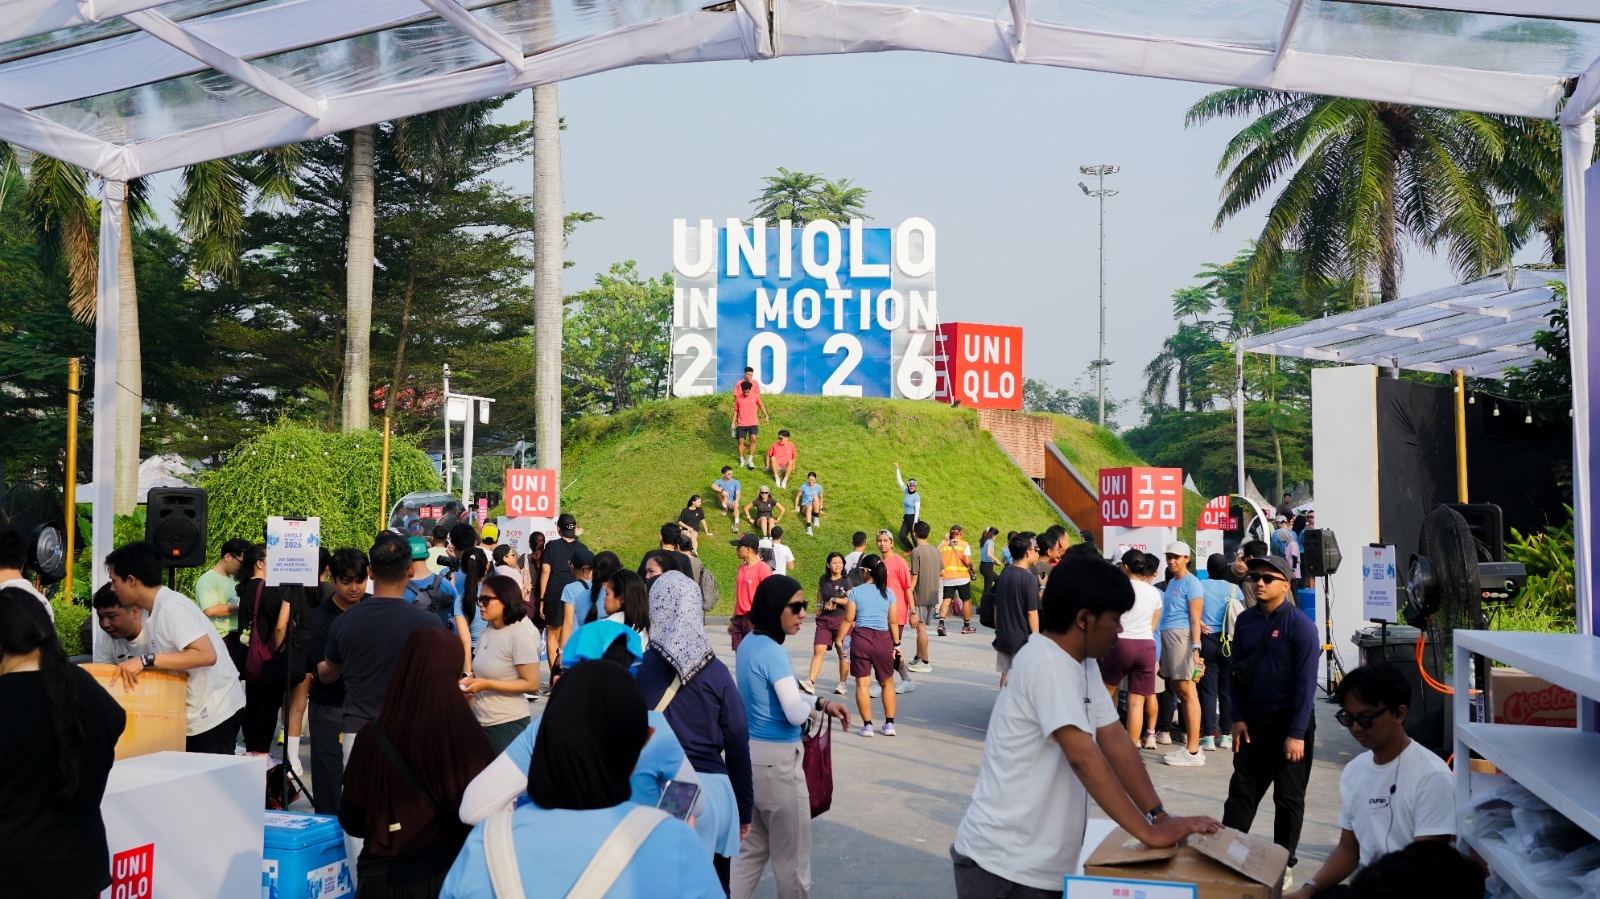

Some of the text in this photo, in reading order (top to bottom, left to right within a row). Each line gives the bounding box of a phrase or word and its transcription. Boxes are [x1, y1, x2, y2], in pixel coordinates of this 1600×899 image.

[673, 217, 936, 289] UNIQLO
[674, 287, 937, 331] IN MOTION
[964, 334, 1011, 364] UNI
[673, 331, 936, 399] 2026
[963, 369, 1014, 403] QLO
[512, 474, 546, 492] UNI
[1102, 475, 1126, 495] UNI
[1138, 474, 1176, 494] ユニ
[512, 494, 548, 514] QLO
[1102, 499, 1128, 522] QLO
[1138, 500, 1176, 519] クロ
[117, 852, 147, 880] UNI
